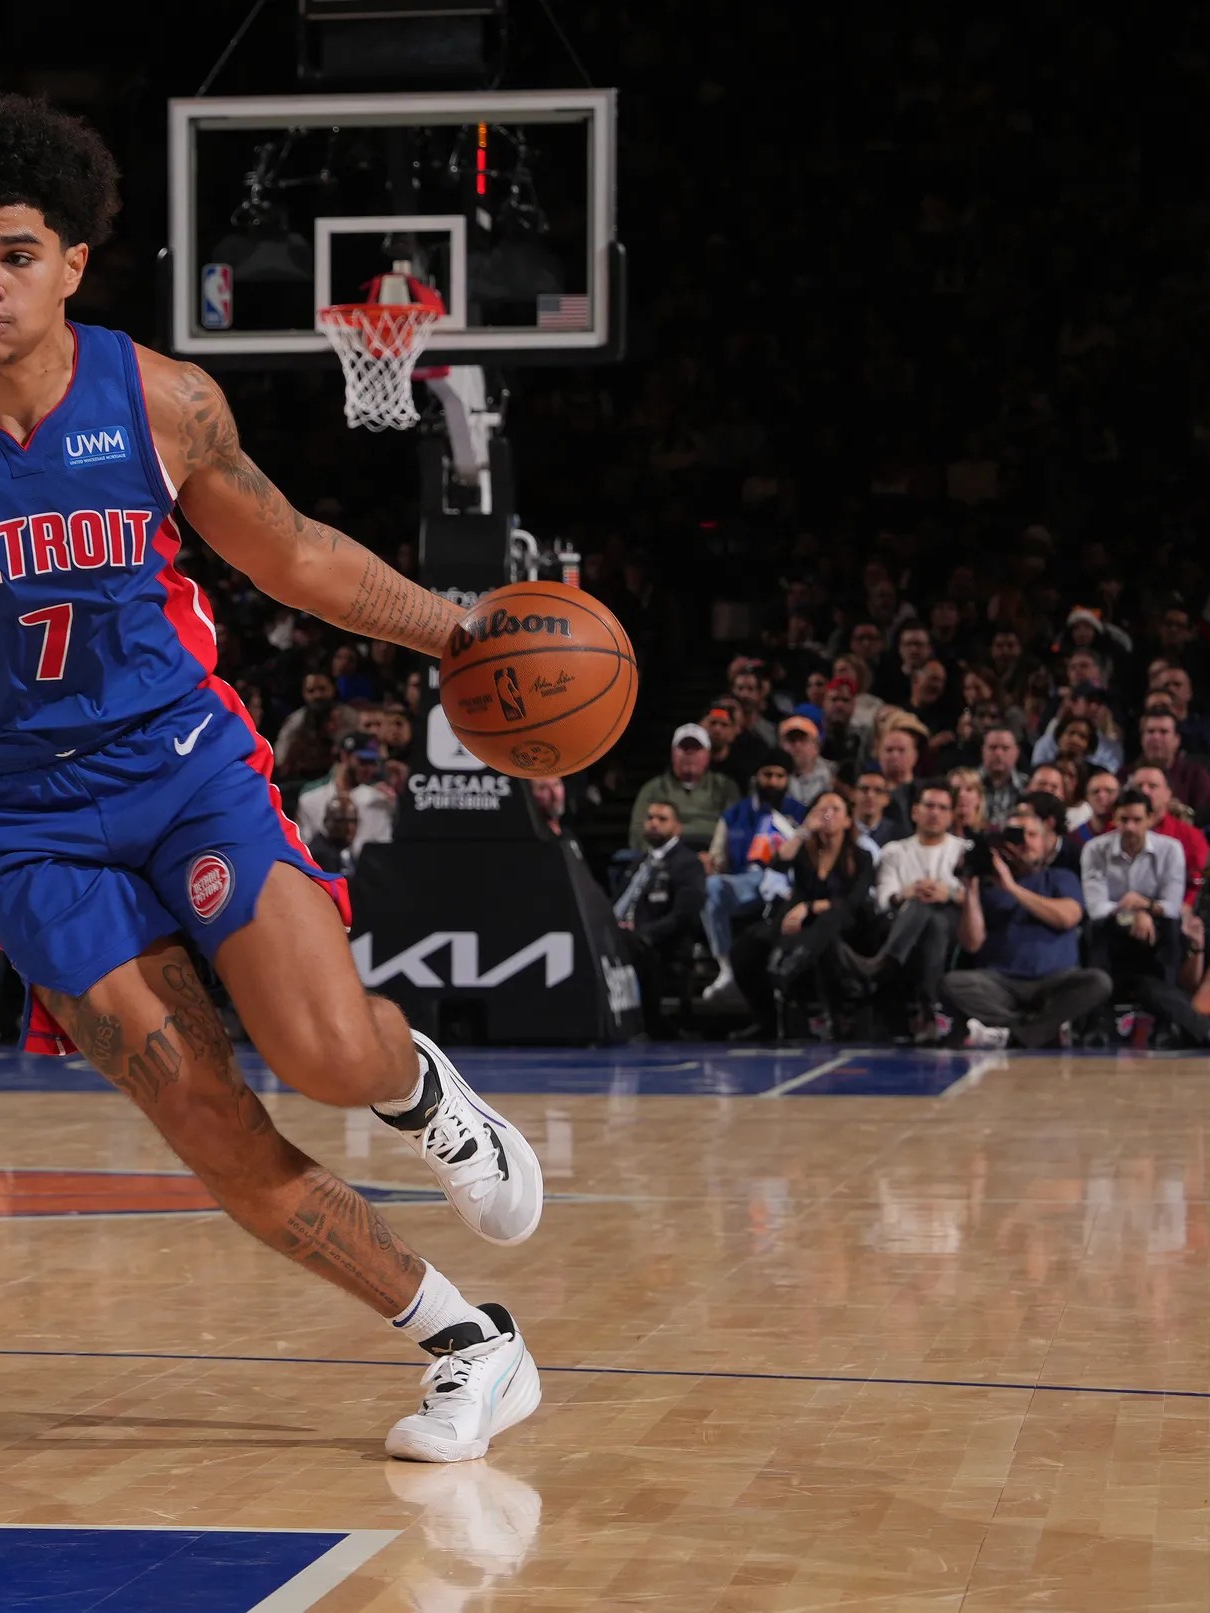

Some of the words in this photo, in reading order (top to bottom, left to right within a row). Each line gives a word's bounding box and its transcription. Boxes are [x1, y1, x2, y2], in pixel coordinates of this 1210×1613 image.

[66, 430, 125, 457] UWM
[18, 602, 74, 681] 7
[408, 773, 512, 797] CAESARS
[350, 930, 575, 989] KIA
